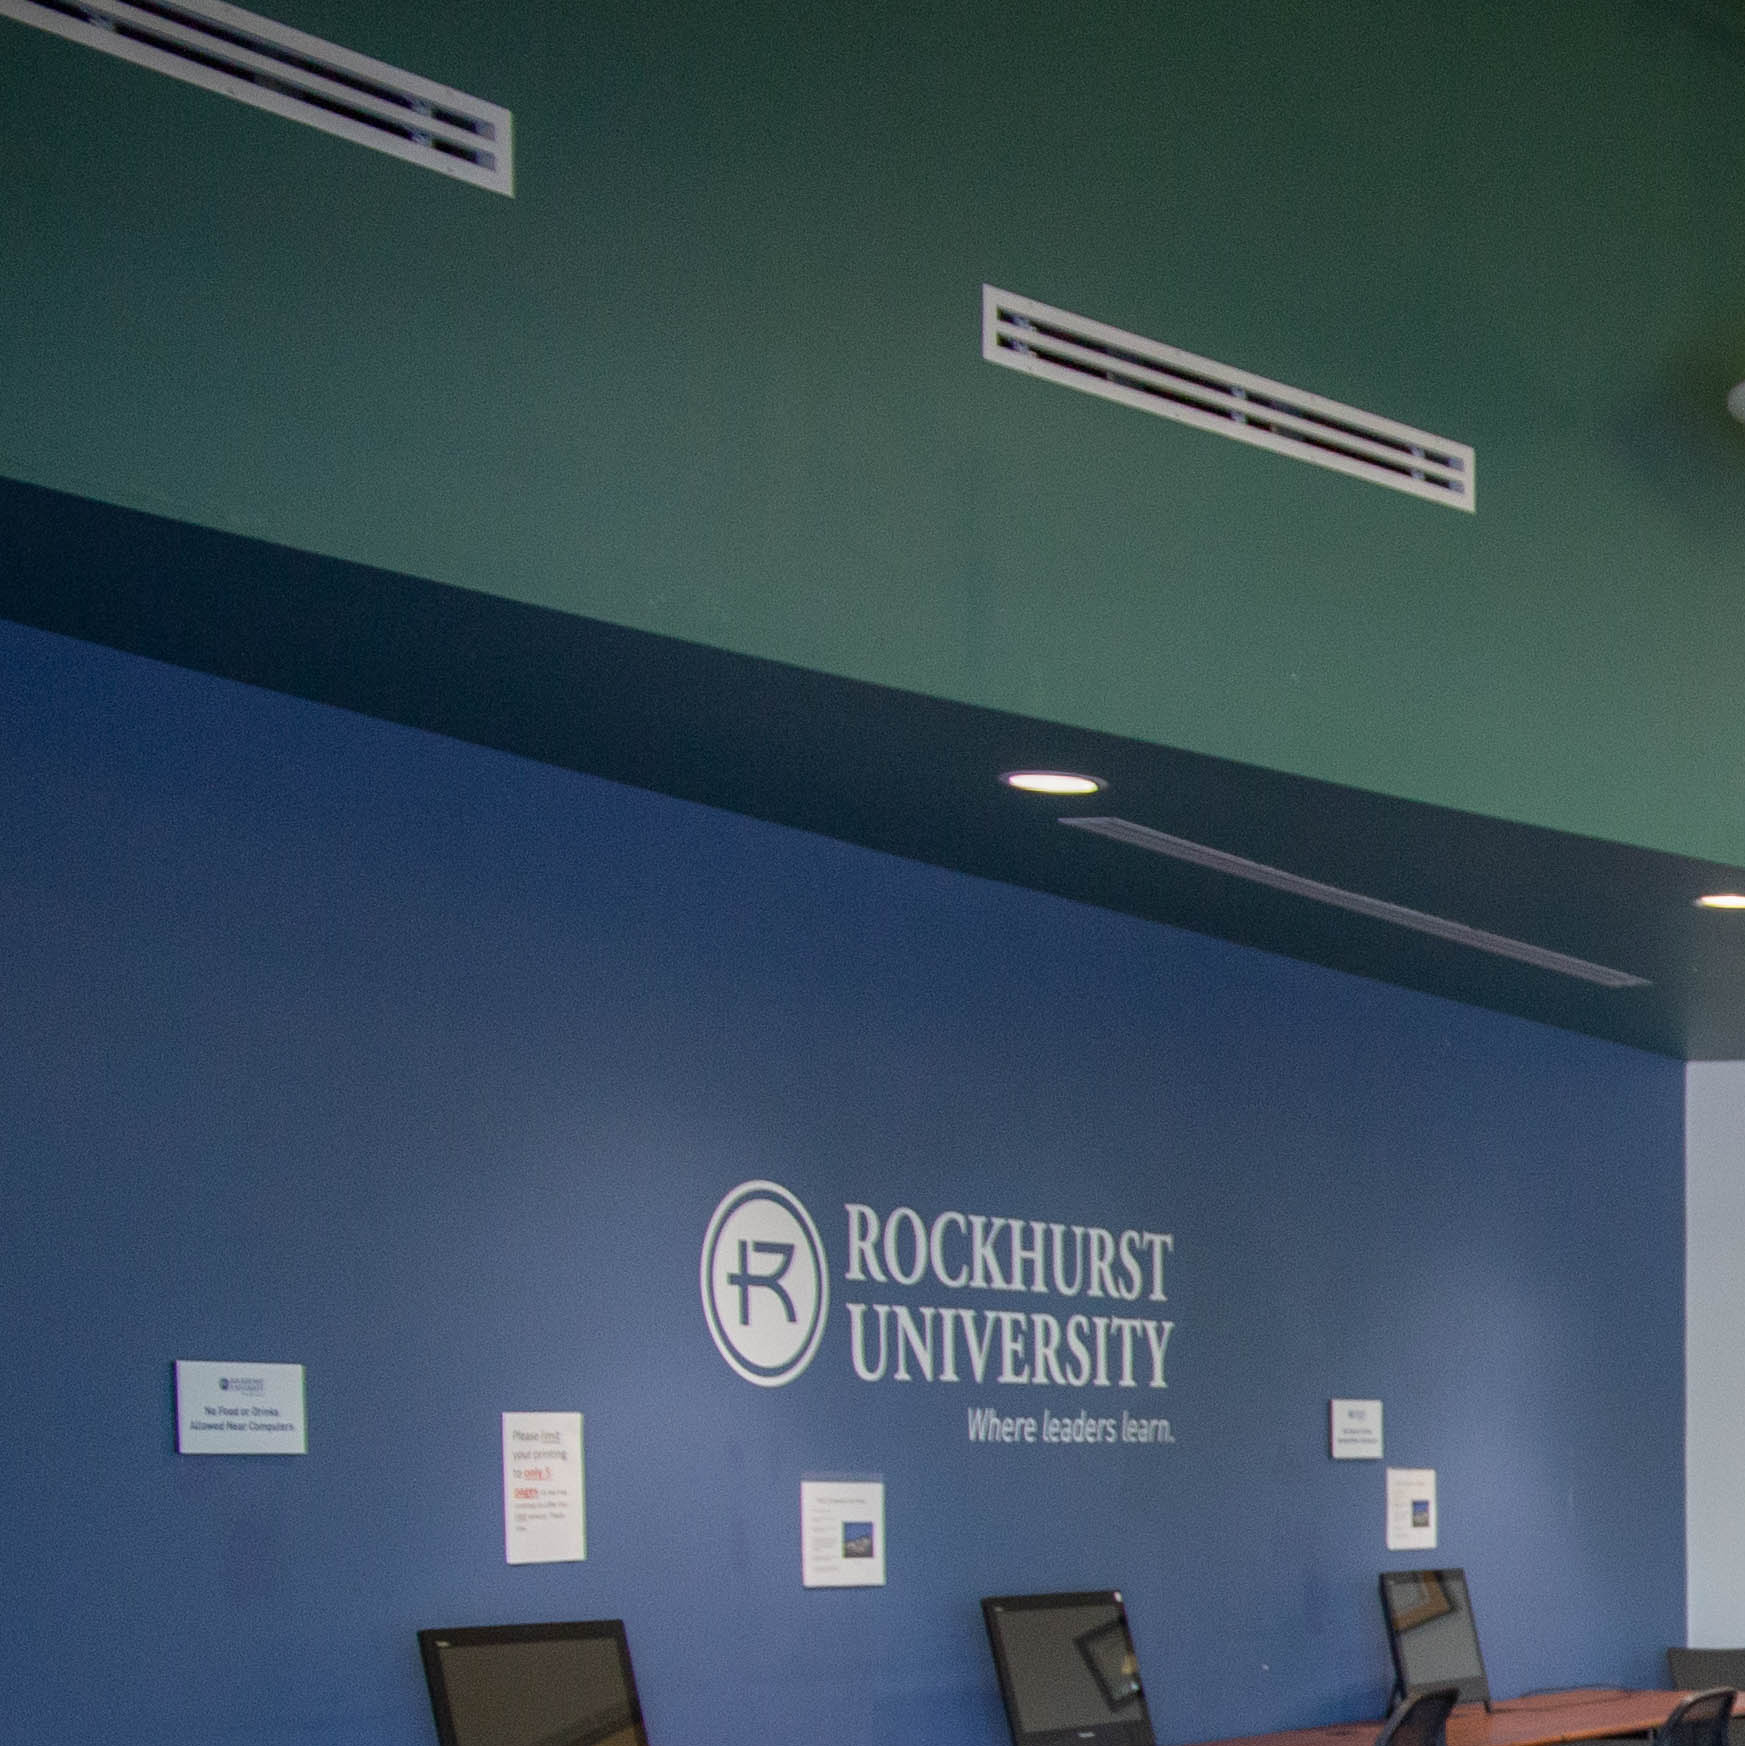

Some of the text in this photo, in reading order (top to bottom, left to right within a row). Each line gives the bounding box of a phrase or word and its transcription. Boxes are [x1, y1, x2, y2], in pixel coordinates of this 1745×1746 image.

[844, 1202, 1175, 1301] ROCKHURST
[846, 1303, 1175, 1388] UNIVERSITY
[204, 1405, 280, 1417] No Food or Drinks
[190, 1420, 295, 1432] Allowed Near Computers
[967, 1407, 1175, 1444] Where leaders learn.
[512, 1430, 540, 1441] Please
[533, 1449, 568, 1462] printing
[523, 1467, 543, 1479] only
